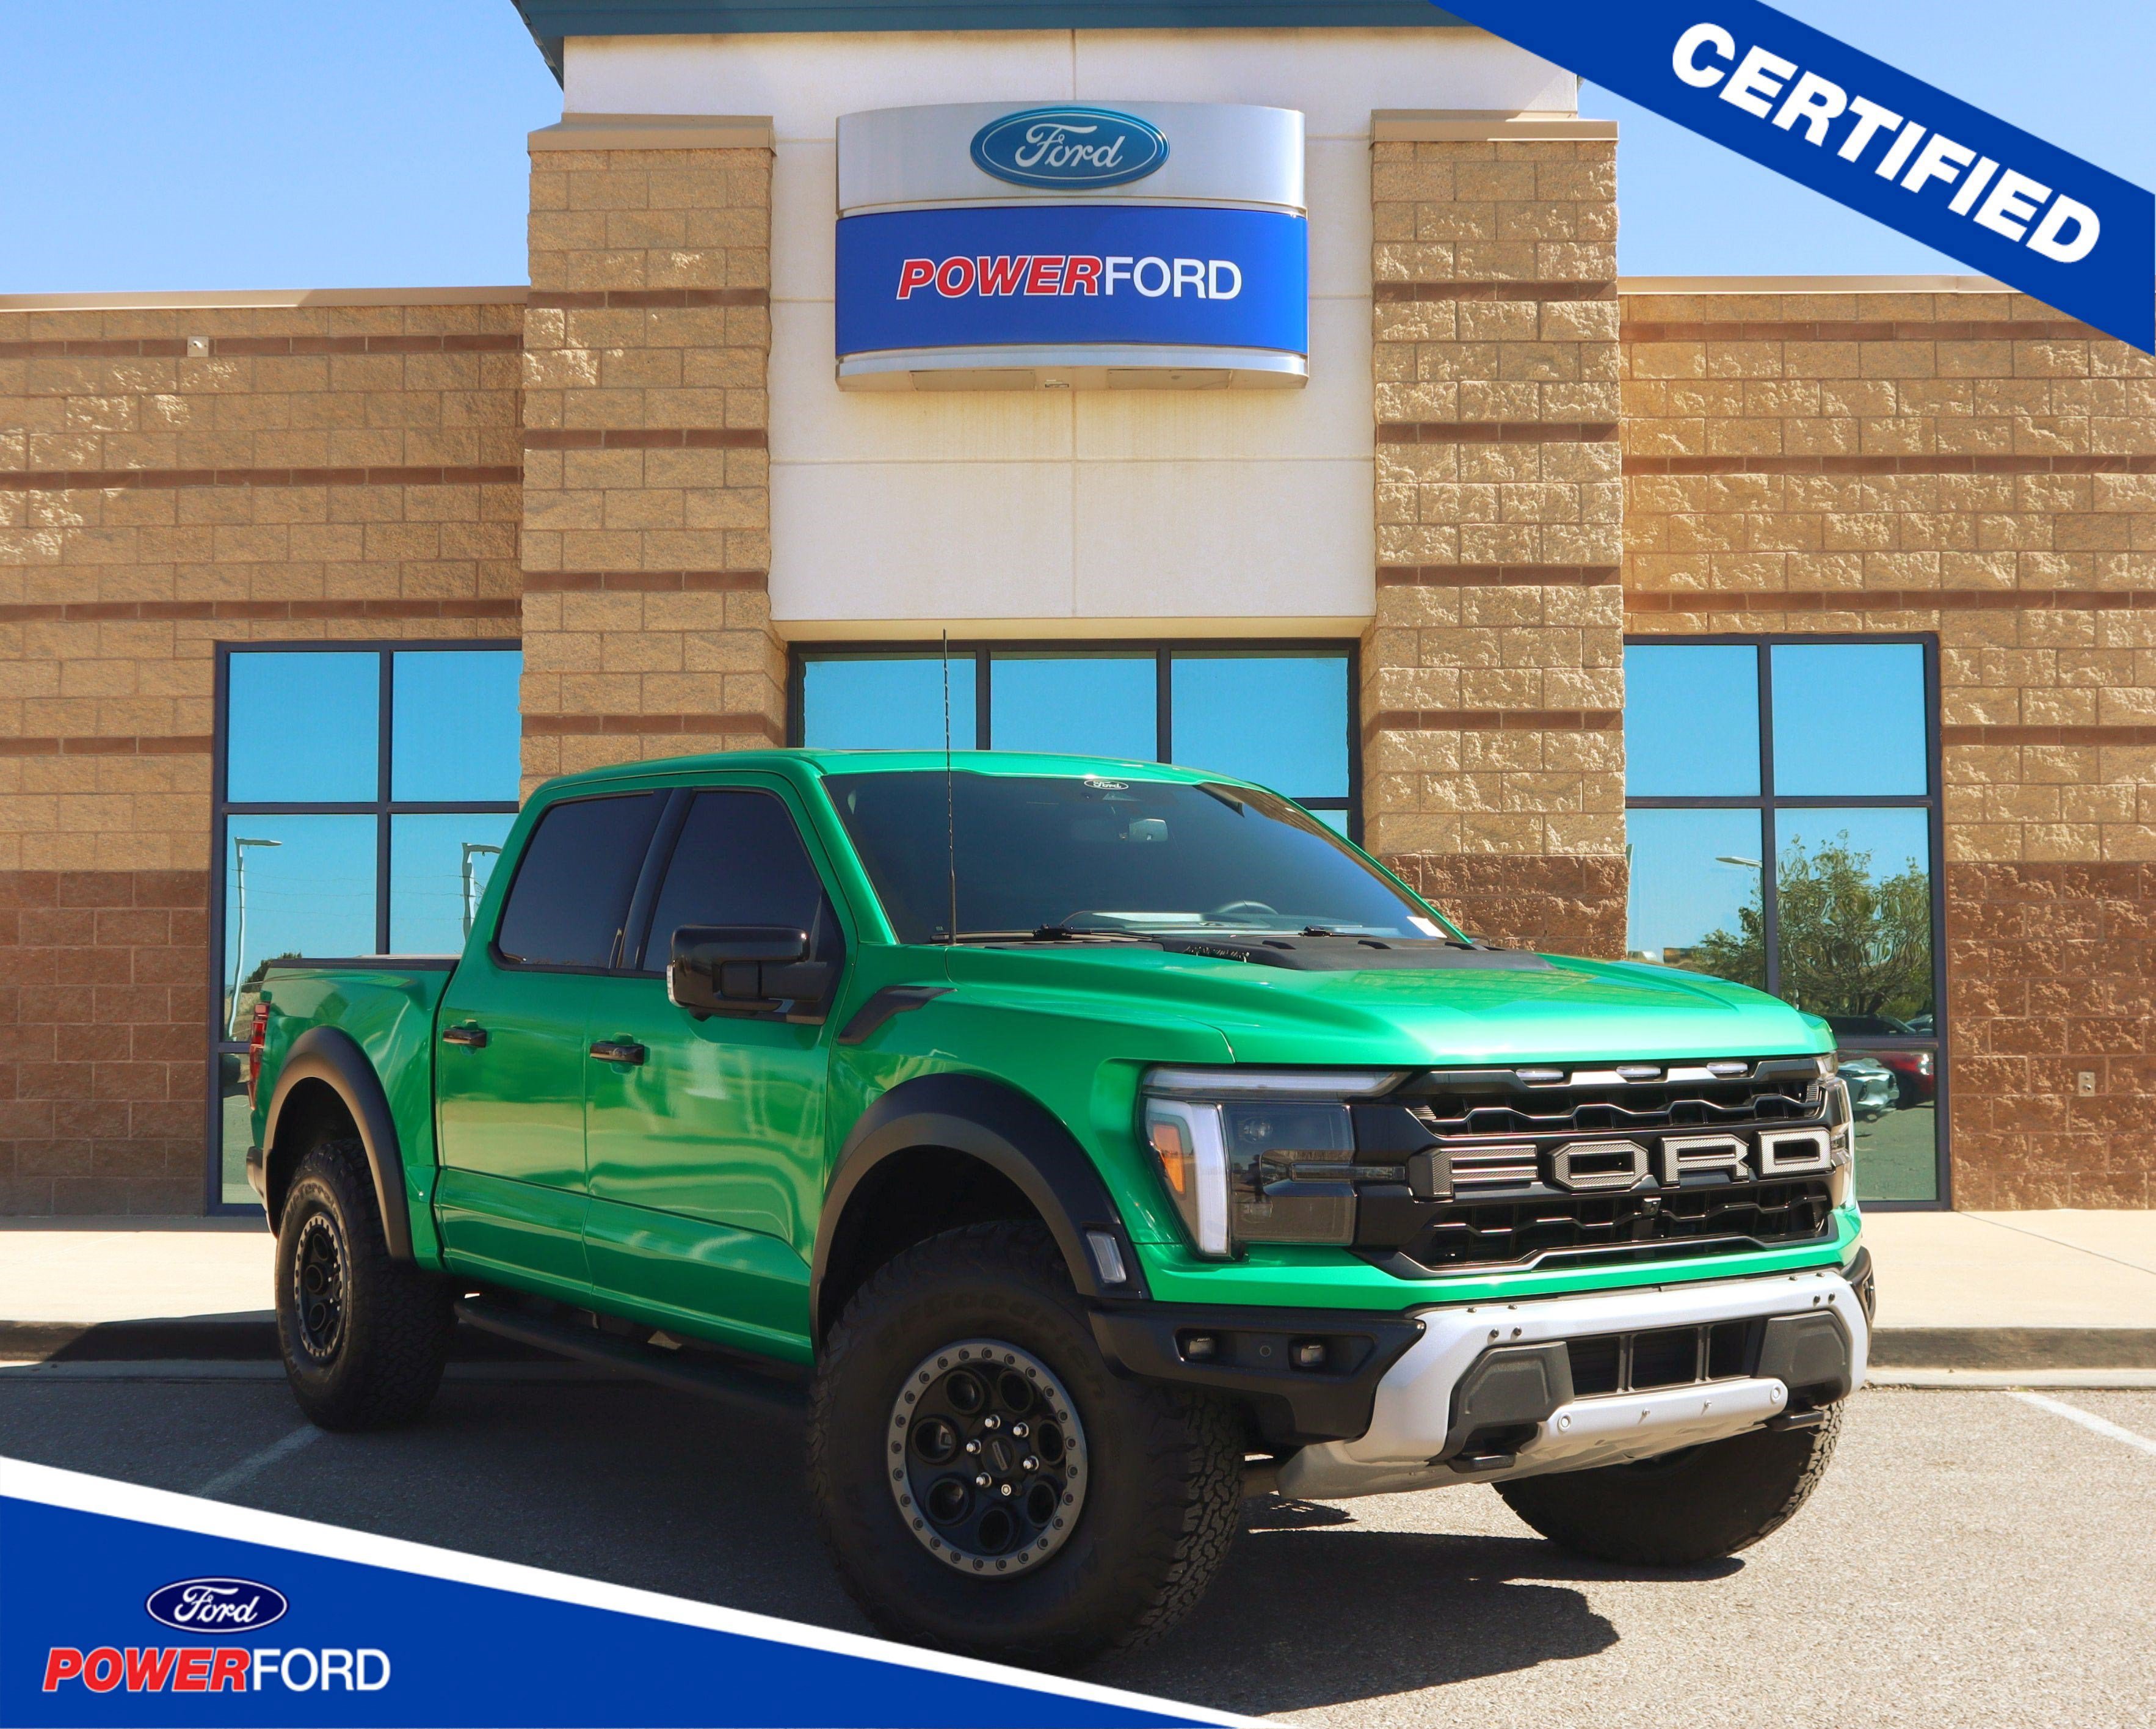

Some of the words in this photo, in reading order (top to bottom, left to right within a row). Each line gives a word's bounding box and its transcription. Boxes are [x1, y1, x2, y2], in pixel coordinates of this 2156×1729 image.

[1014, 123, 1125, 168] Ford
[1092, 781, 1122, 789] Ford
[1415, 1127, 1832, 1199] FORD
